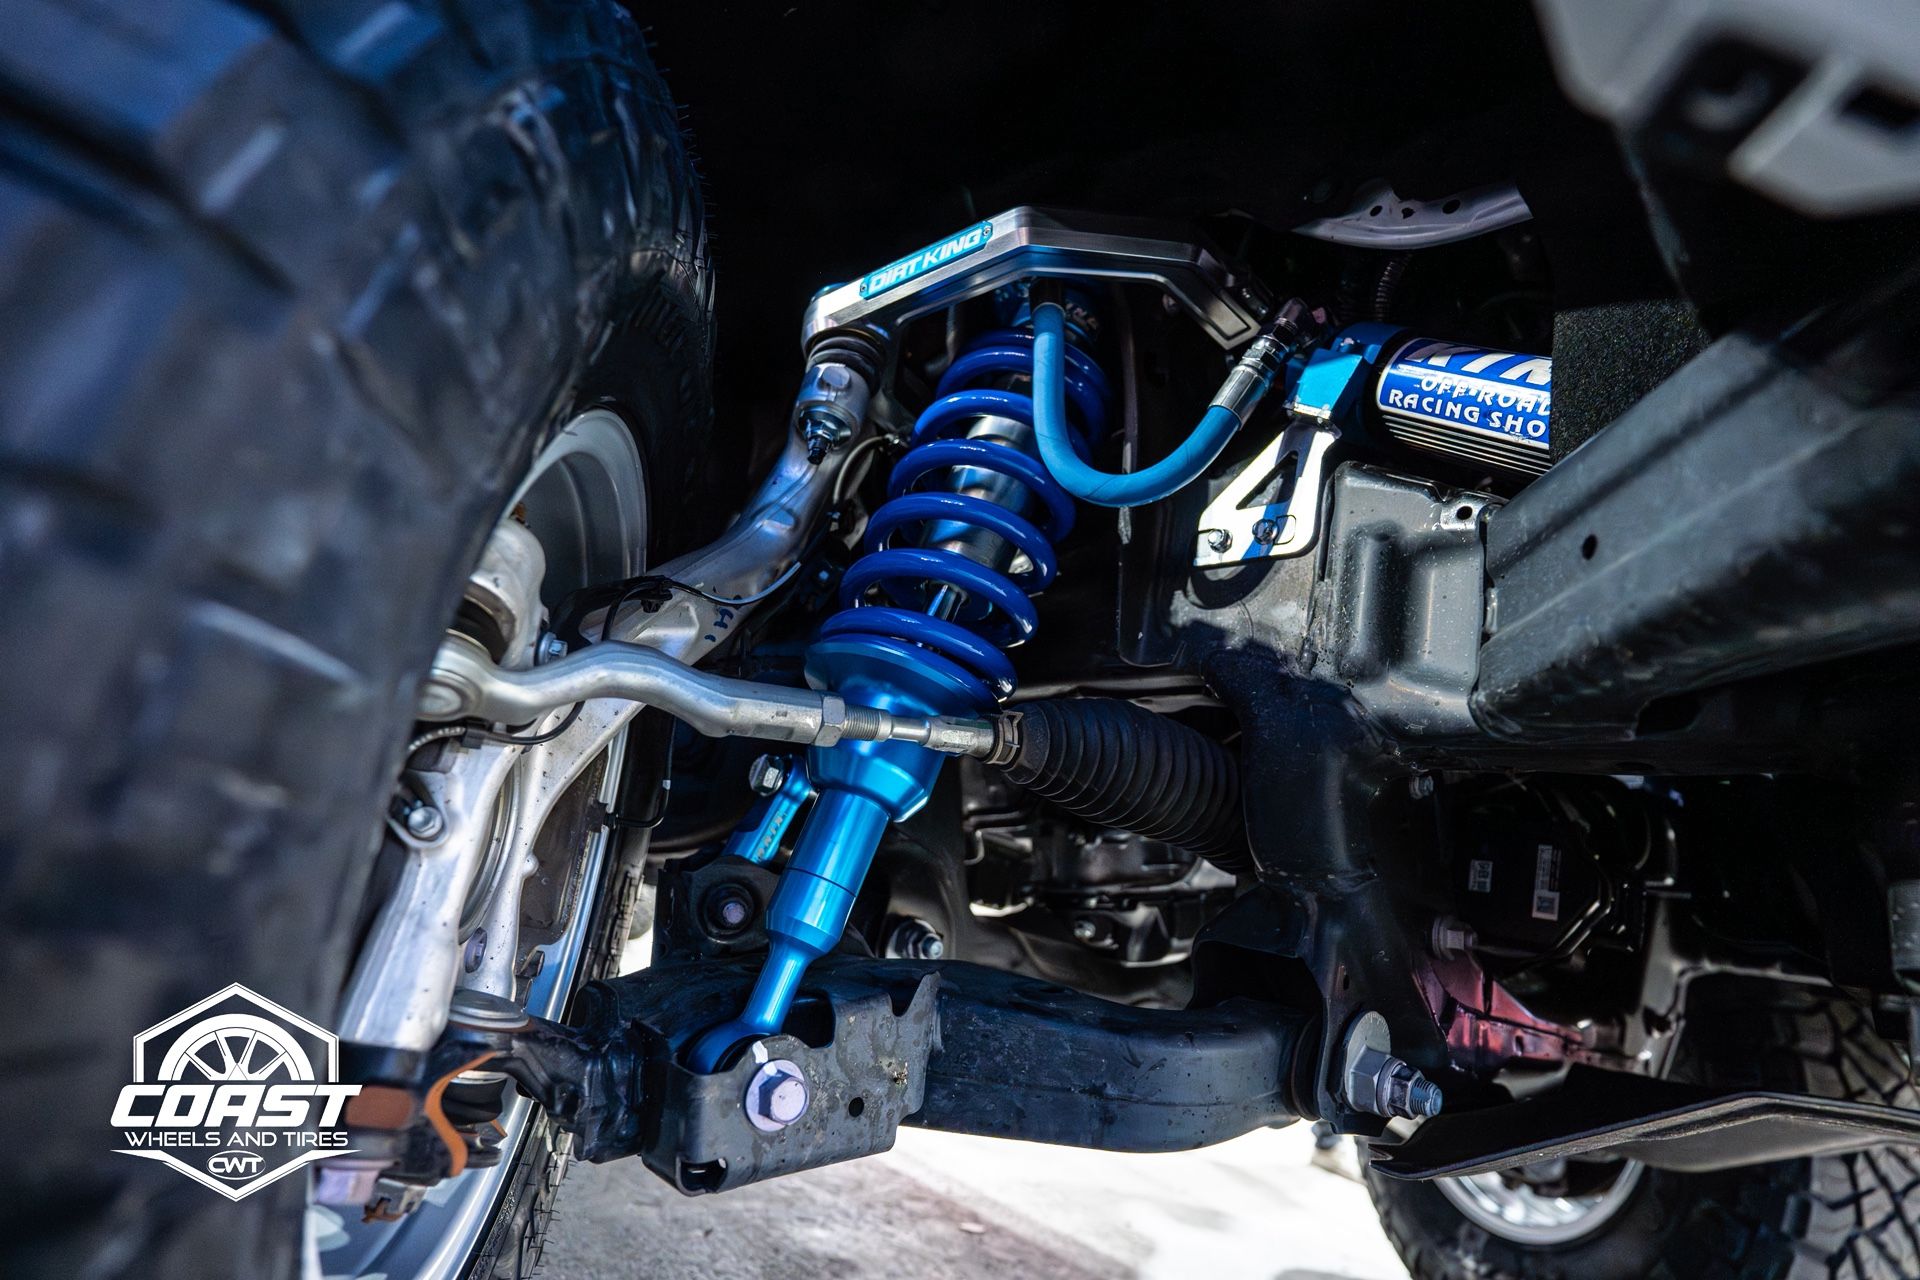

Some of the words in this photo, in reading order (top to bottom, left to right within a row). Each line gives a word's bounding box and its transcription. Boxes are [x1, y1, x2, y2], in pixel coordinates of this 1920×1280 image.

[868, 254, 924, 294] DIRT
[922, 228, 983, 269] KING
[1388, 389, 1480, 424] RACING
